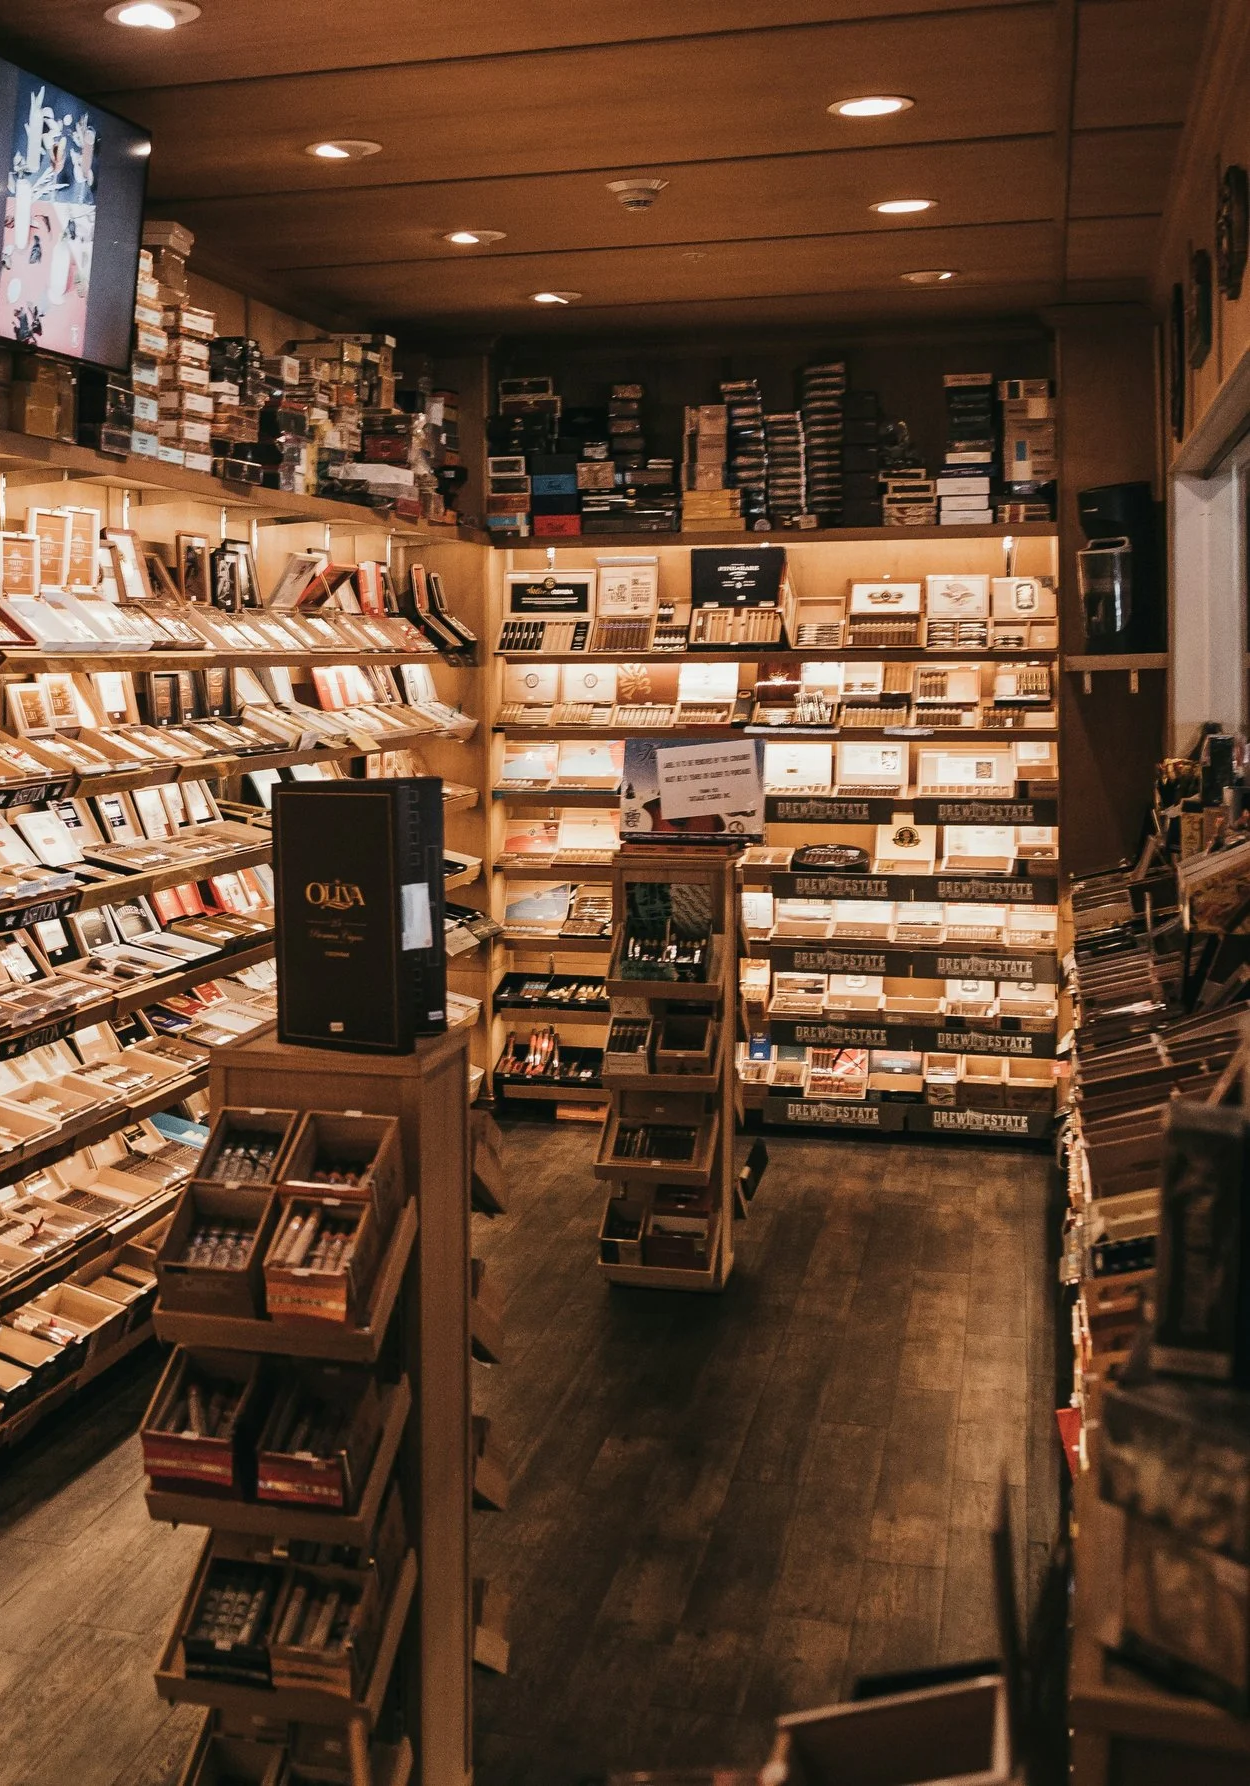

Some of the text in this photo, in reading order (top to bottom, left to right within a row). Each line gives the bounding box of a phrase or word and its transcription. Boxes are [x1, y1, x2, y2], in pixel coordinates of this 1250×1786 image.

[9, 784, 48, 806] ASHTON
[777, 802, 869, 816] DREW ESTATE
[938, 804, 1034, 816] DREW ESTATE
[795, 878, 888, 893] DREW ESTATE
[938, 881, 1033, 895] DREW ESTATE
[20, 902, 59, 925] ASHTON
[794, 952, 886, 968] DREW ESTATE
[937, 958, 1033, 973] DREW ESTATE
[796, 1026, 887, 1042] DREW ESTATE
[938, 1032, 1032, 1049] DREW ESTATE
[788, 1104, 878, 1120] DREW ESTATE
[933, 1111, 969, 1124] DREW
[984, 1114, 1028, 1128] ESTATE
